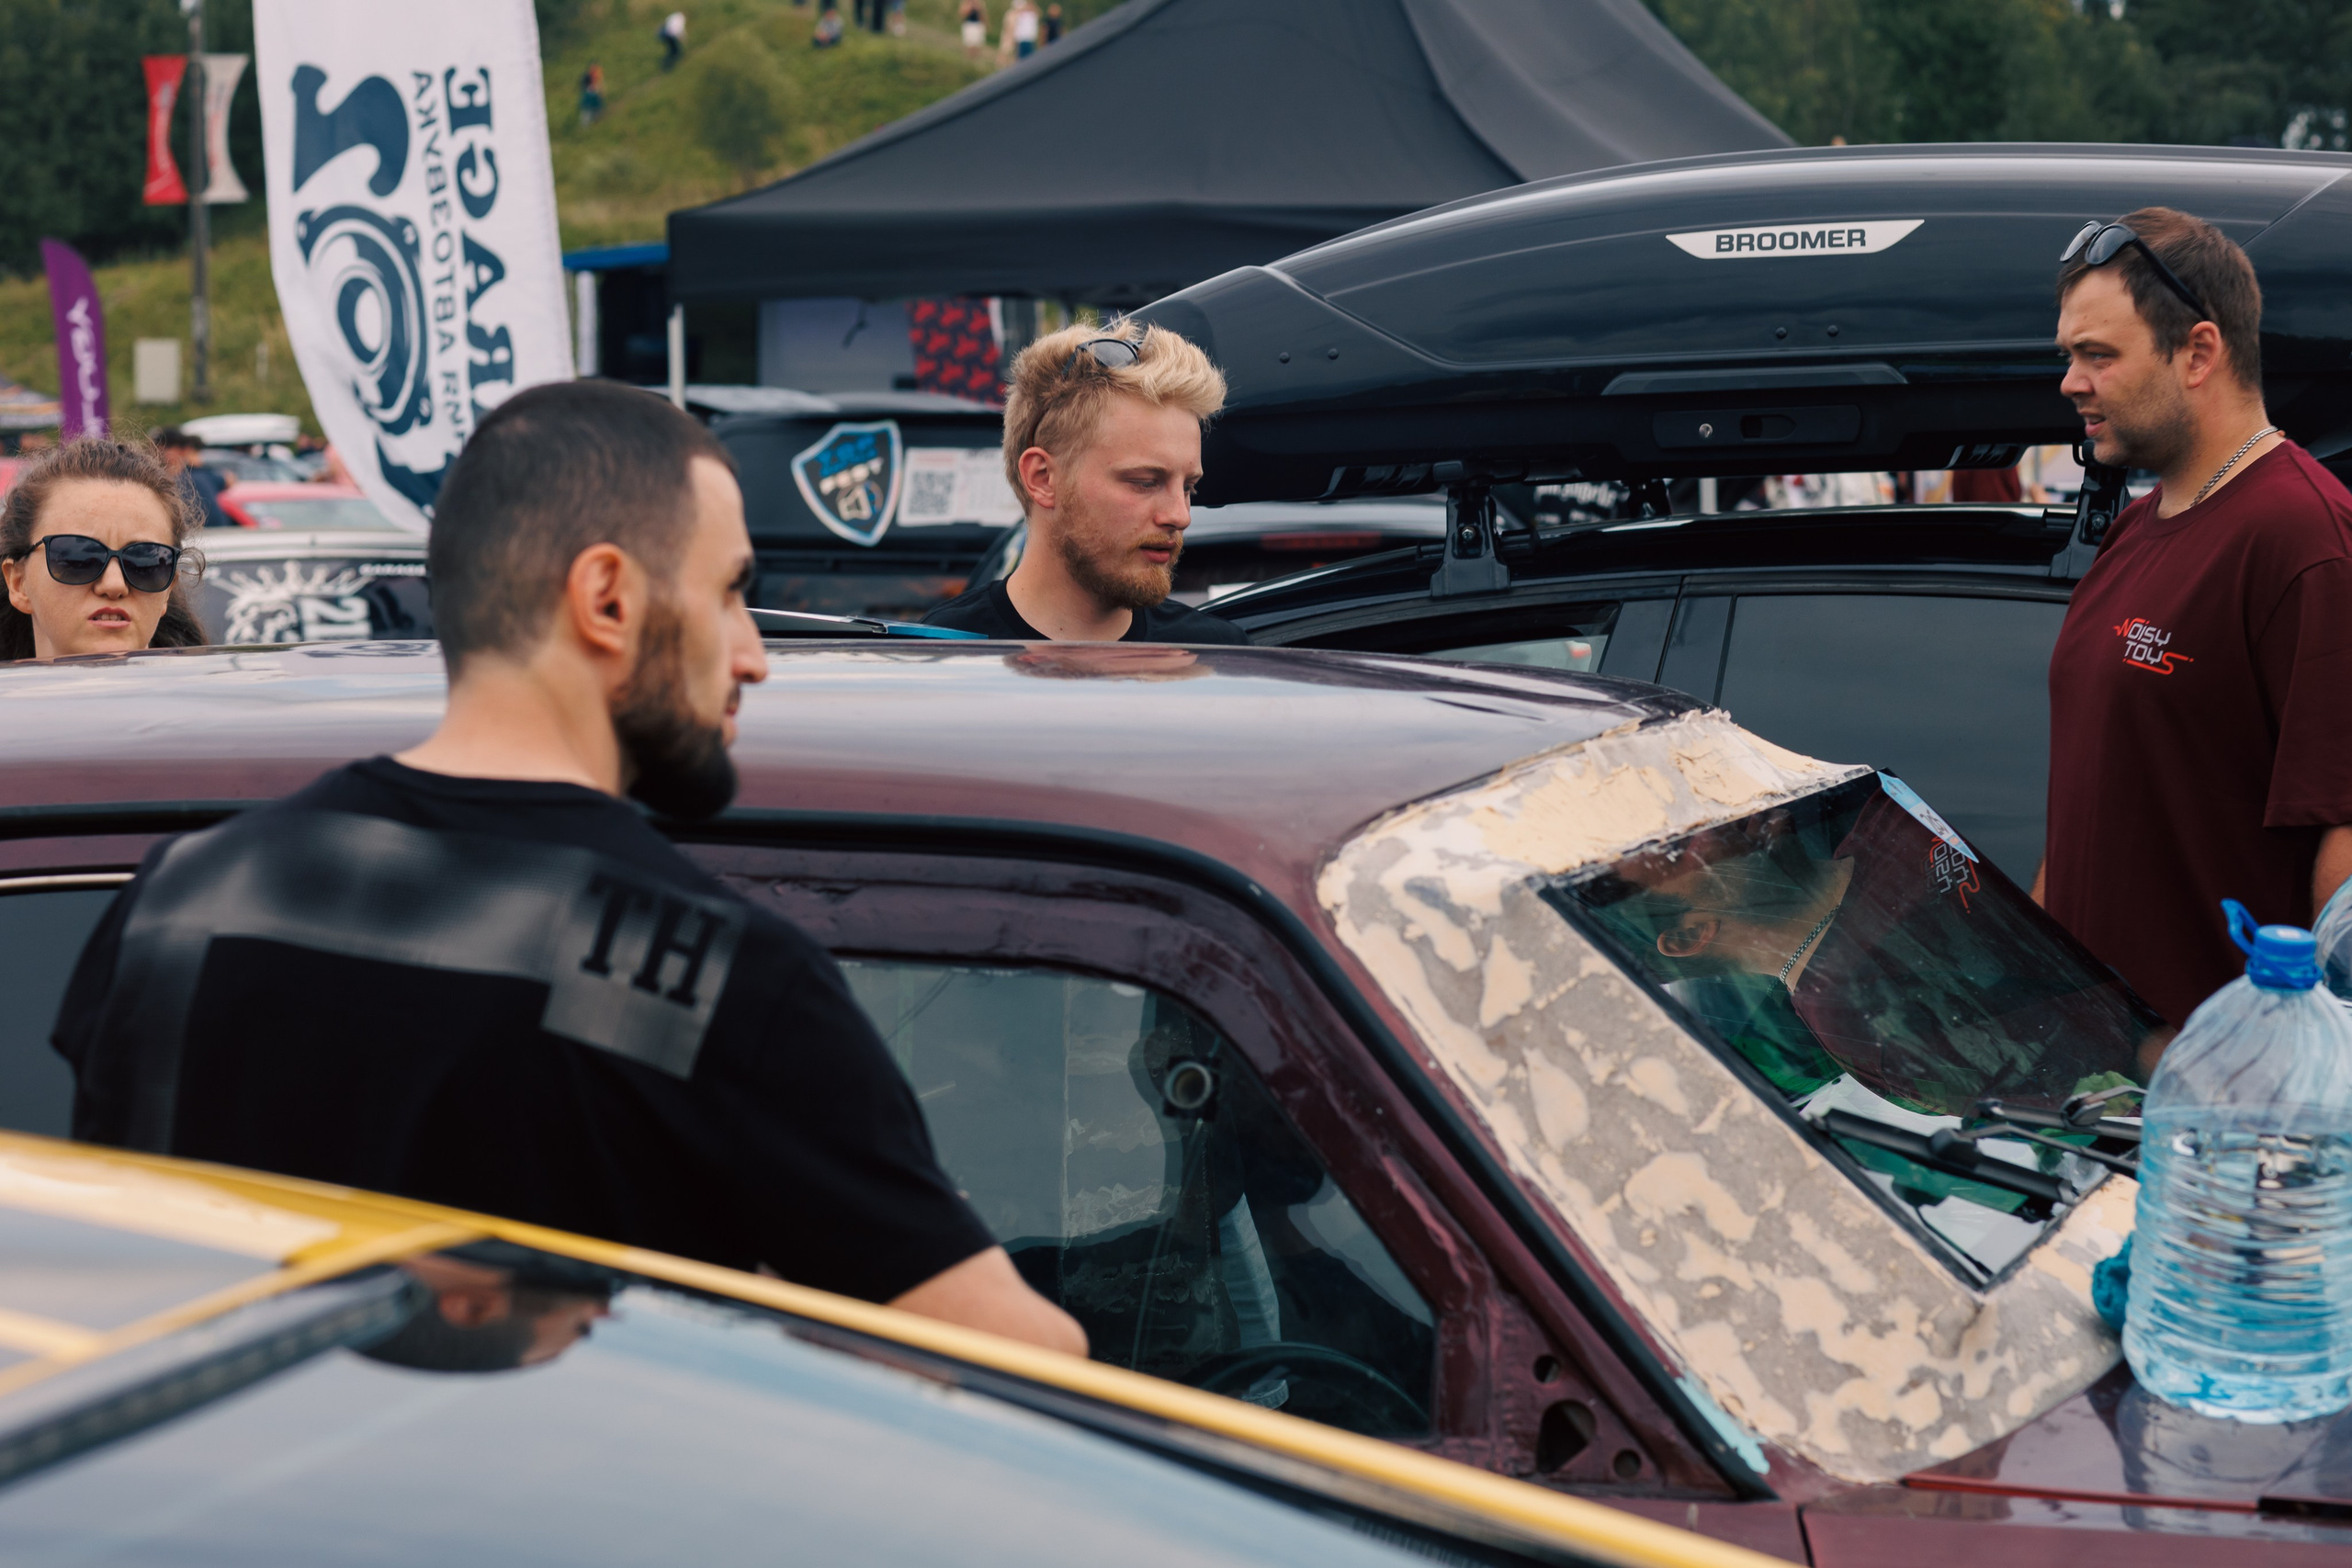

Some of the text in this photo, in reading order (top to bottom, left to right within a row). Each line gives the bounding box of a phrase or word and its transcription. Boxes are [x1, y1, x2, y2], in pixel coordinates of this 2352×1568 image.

[1715, 228, 1866, 253] BROOMER
[2113, 617, 2172, 647] NOISY
[2123, 640, 2194, 675] TOYS
[580, 875, 729, 1009] TH
